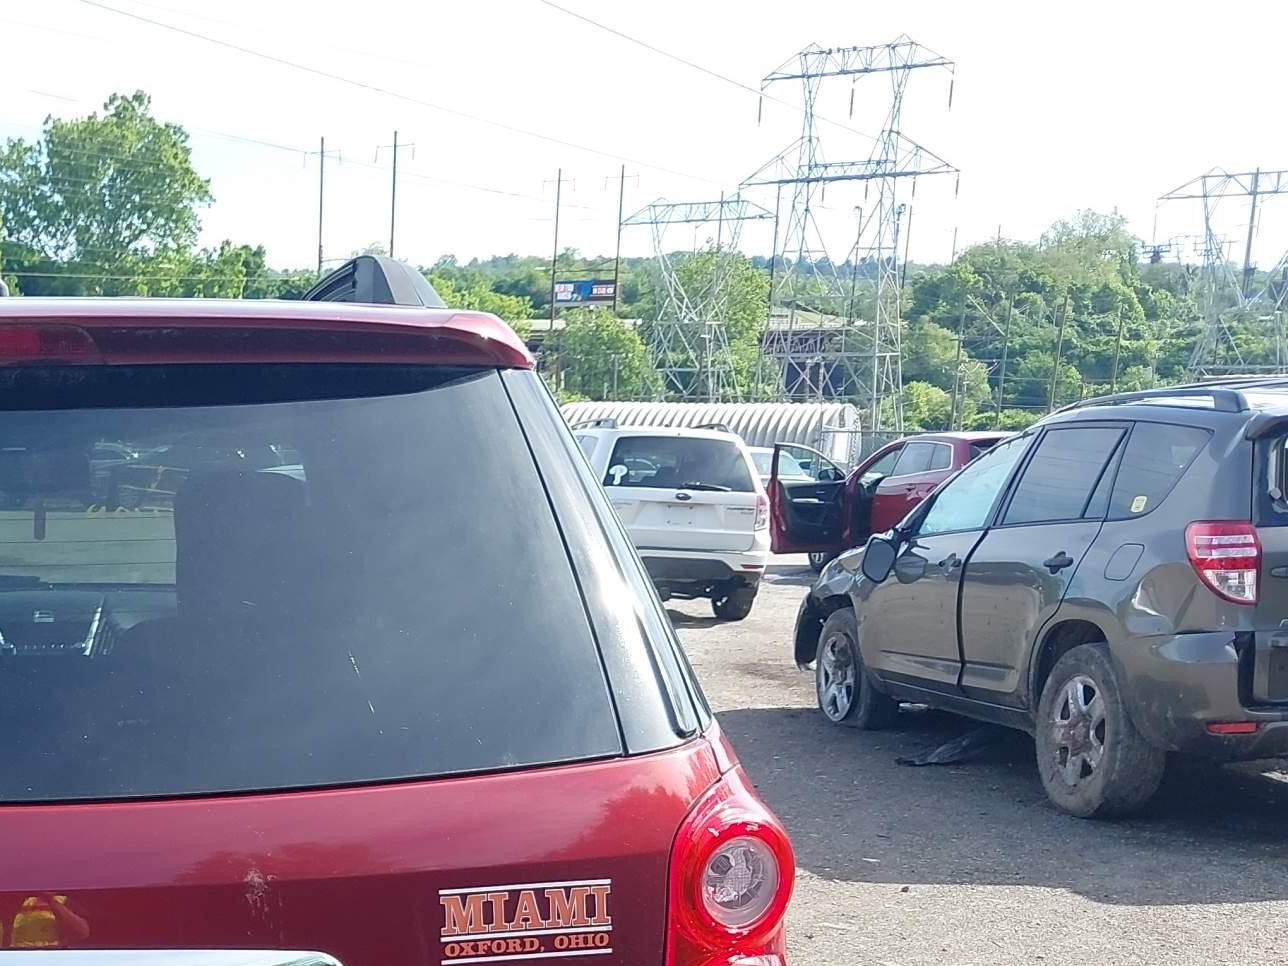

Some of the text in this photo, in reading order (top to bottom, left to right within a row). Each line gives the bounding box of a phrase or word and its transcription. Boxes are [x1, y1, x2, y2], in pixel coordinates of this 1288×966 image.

[439, 885, 612, 936] MIAMI
[444, 932, 610, 958] OXFORD, OHIO
